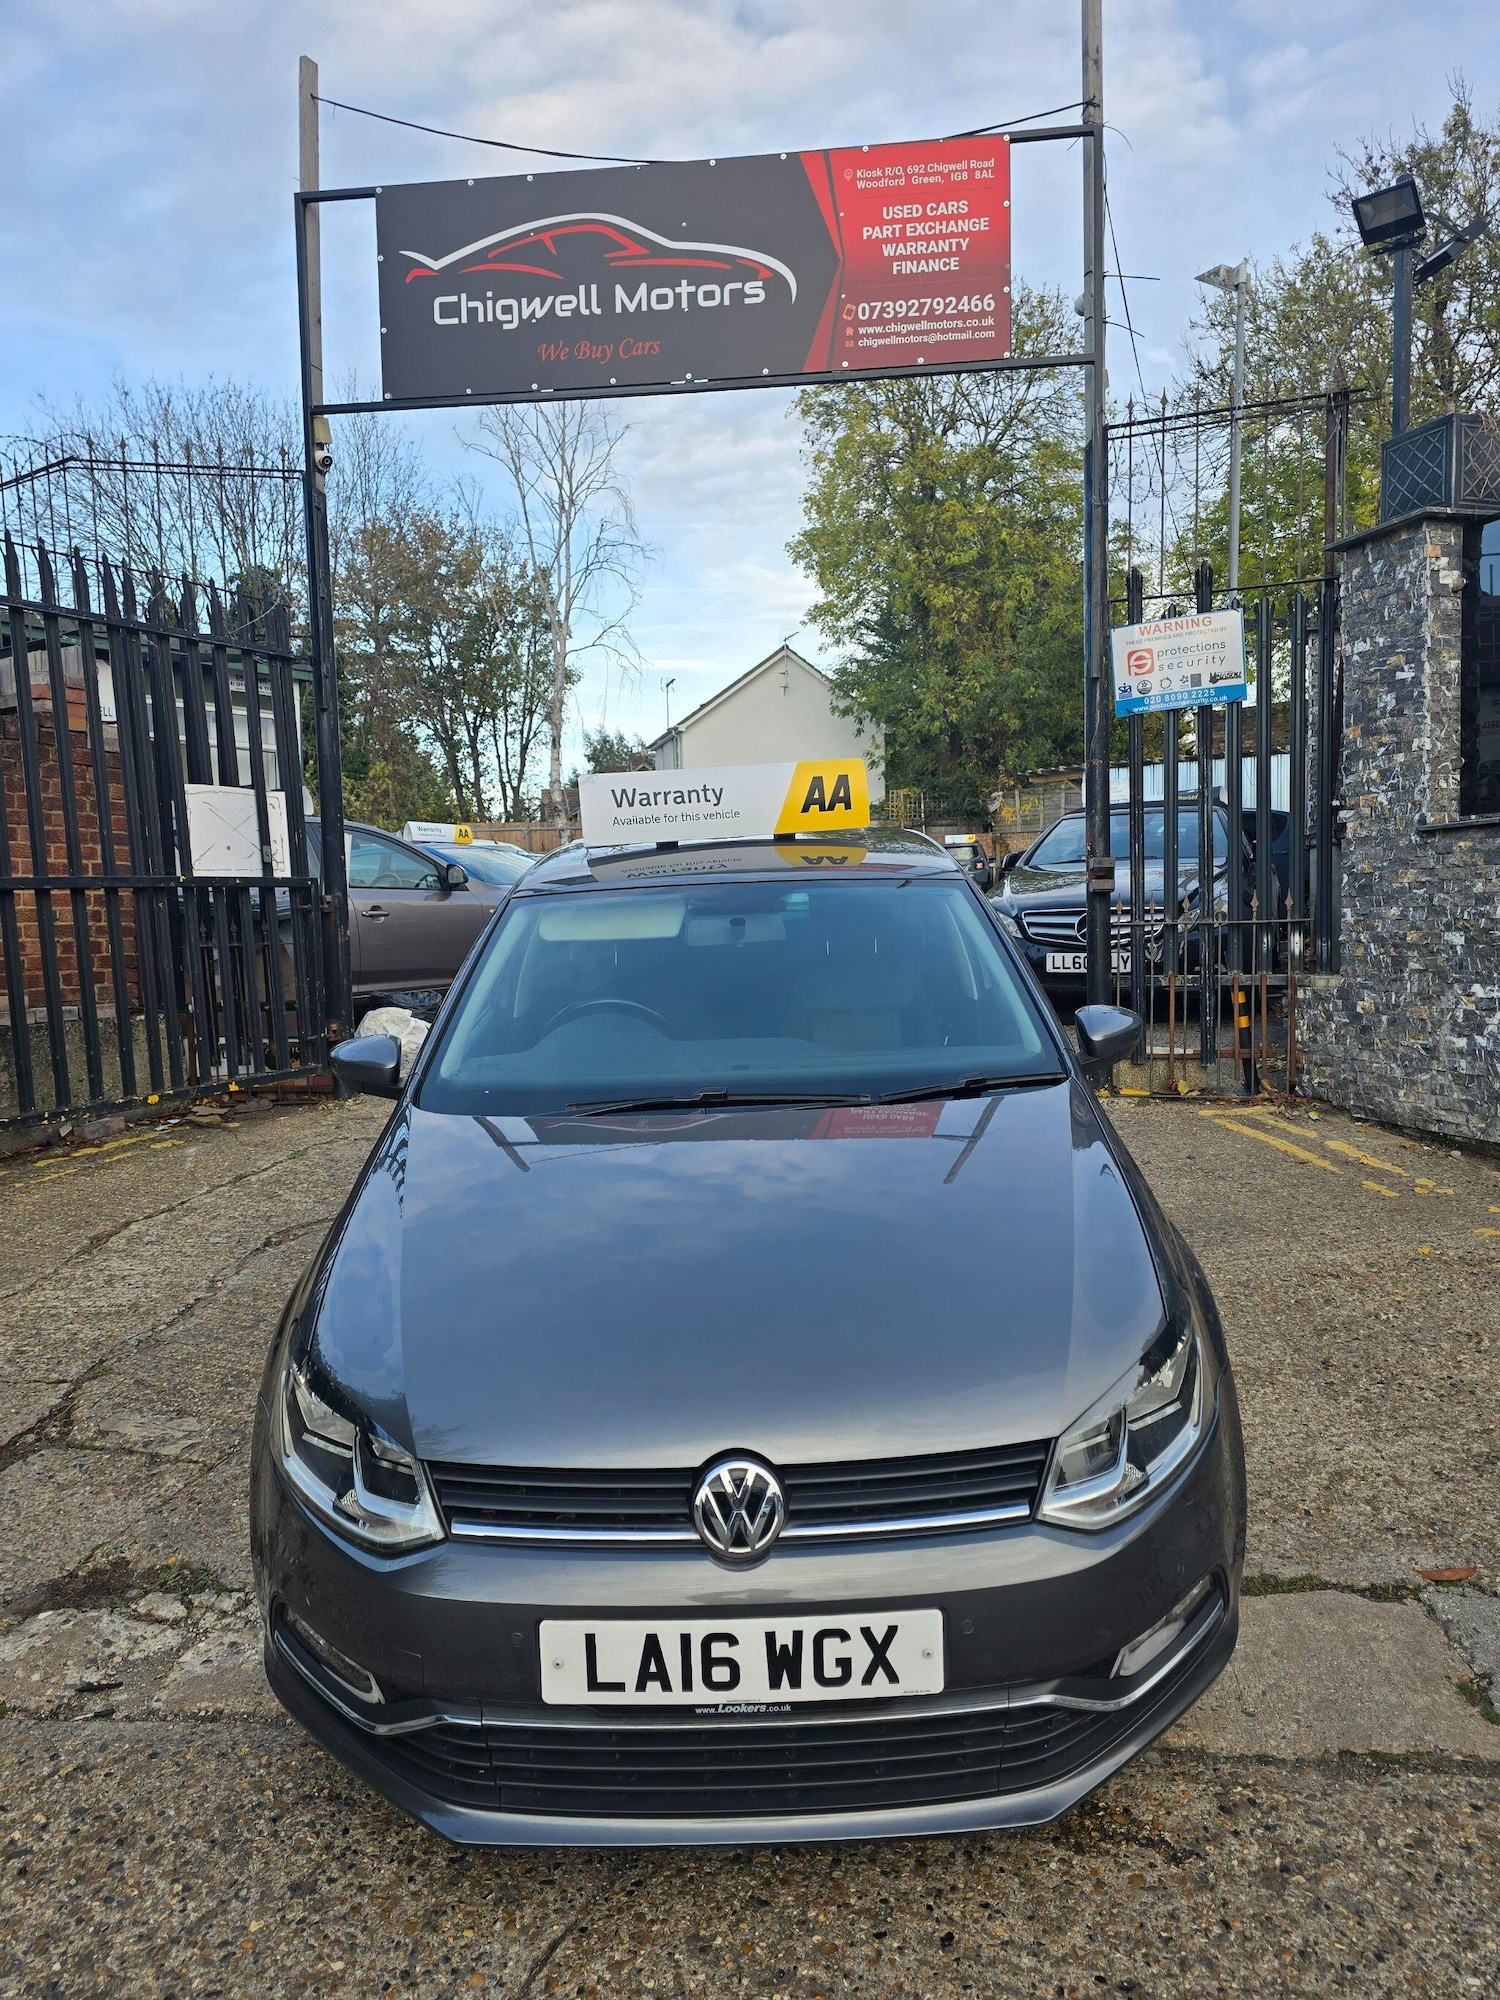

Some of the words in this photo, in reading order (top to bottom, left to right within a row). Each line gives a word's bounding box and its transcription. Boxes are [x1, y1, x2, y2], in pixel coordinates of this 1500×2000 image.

[856, 167, 882, 178] Kiosk
[885, 166, 905, 177] R/O,
[907, 164, 925, 174] 692
[927, 159, 968, 174] Chigwell
[970, 158, 995, 169] Road
[856, 177, 905, 189] Woodford
[911, 174, 944, 185] Green,
[951, 172, 968, 182] IG8
[974, 169, 995, 179] 8AL
[882, 203, 922, 220] USED
[926, 200, 968, 216] CARS
[862, 223, 902, 240] PART
[906, 217, 990, 237] EXCHANGE
[882, 237, 970, 257] WARRANTY
[892, 257, 960, 275] FINANCE
[432, 284, 602, 330] Chigwell
[614, 279, 766, 314] Motors
[857, 293, 995, 321] 07392792466
[858, 316, 995, 335] www.chigwellmotors.co.uk
[858, 330, 995, 348] chigwellmotors@hotmail.com
[537, 341, 569, 362] We
[574, 340, 614, 365] Buy
[618, 337, 661, 360] Cars
[1125, 638, 1143, 646] THESE
[1143, 634, 1172, 643] PREMISES
[1185, 627, 1219, 636] PROTECTED
[1138, 616, 1213, 637] WARNING
[1156, 640, 1226, 660] protections
[1158, 655, 1226, 672] security
[1144, 695, 1161, 705] 020
[1164, 691, 1189, 701] 8090
[1191, 688, 1216, 698] 2225
[610, 783, 724, 808] Warranty
[800, 774, 852, 813] AA
[612, 812, 661, 827] Available
[663, 812, 679, 823] for
[681, 811, 700, 822] this
[702, 809, 740, 821] vehicle
[417, 826, 441, 834] Warranty
[458, 828, 469, 838] AA
[584, 1632, 741, 1694] LA16
[764, 1624, 900, 1690] WGX
[695, 1702, 792, 1715] www.Lookers.co.uk
